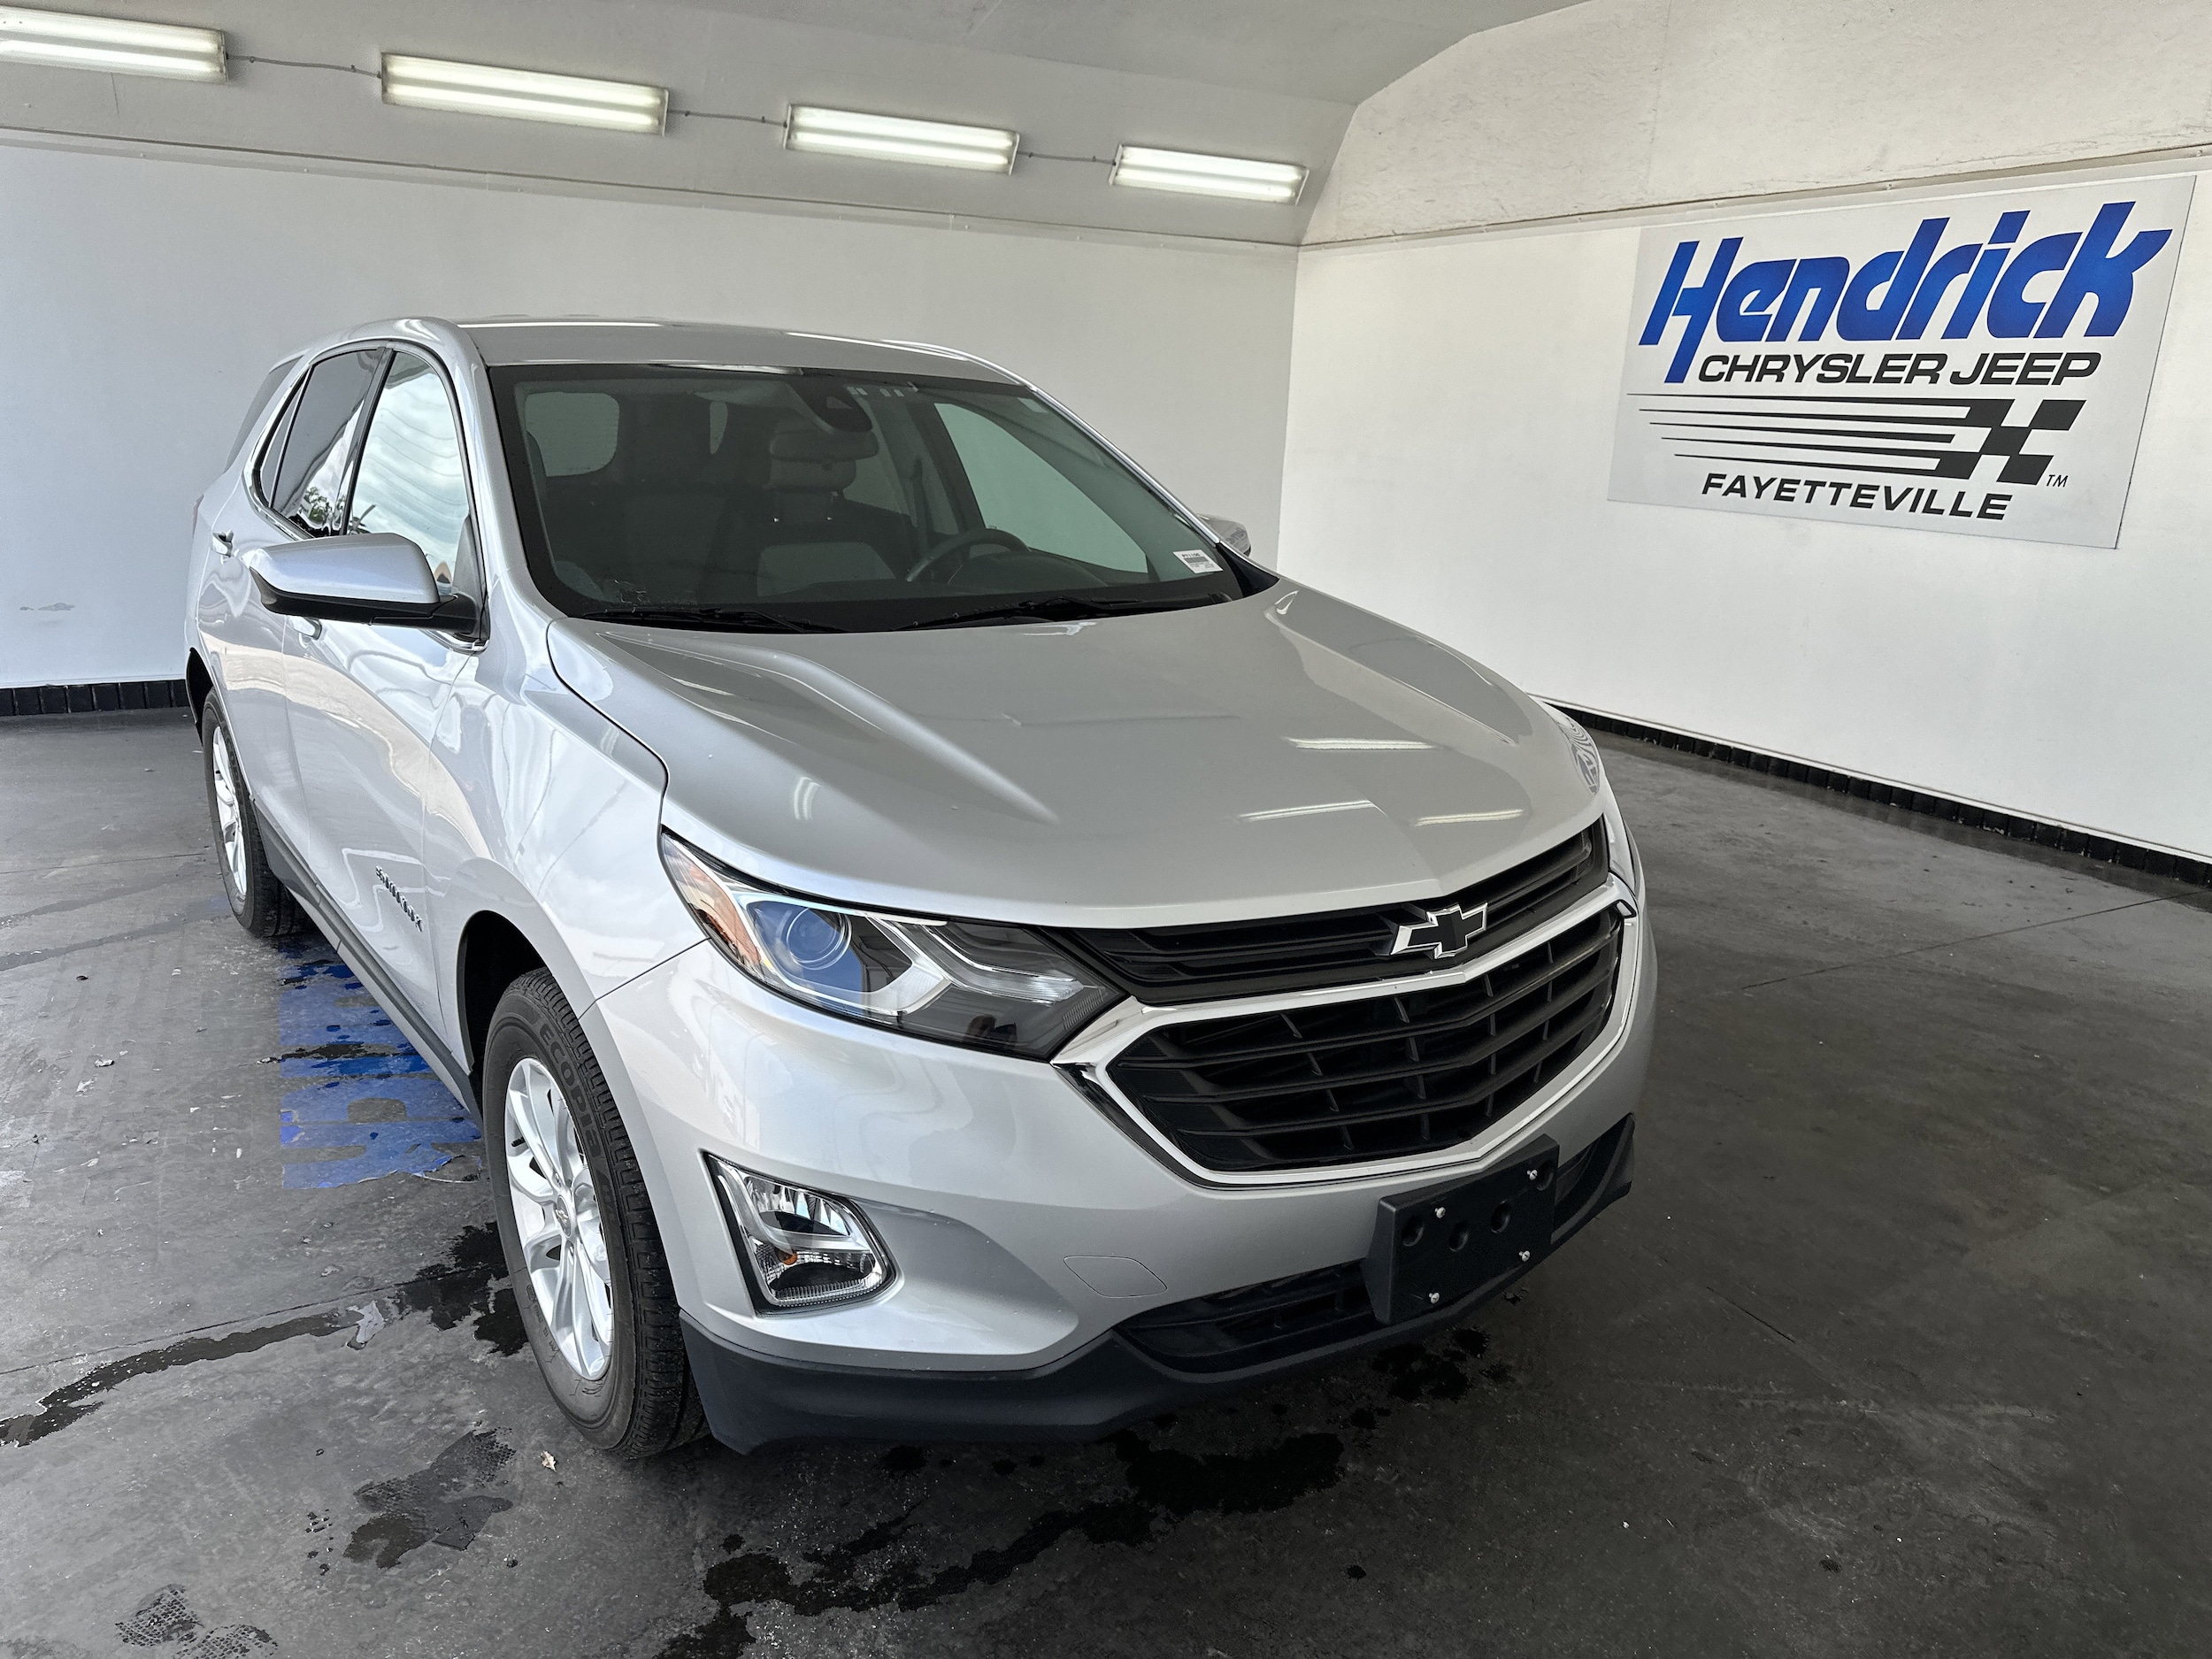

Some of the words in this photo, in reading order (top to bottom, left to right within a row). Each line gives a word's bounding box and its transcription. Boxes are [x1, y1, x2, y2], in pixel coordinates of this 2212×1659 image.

[1640, 201, 2172, 383] Hendrick
[1698, 353, 1949, 385] CHRYSLER
[1949, 351, 2102, 386] JEEP
[1701, 472, 2013, 520] FAYETTEVILLE
[2046, 474, 2069, 488] TM
[539, 1023, 602, 1158] ECOPIA
